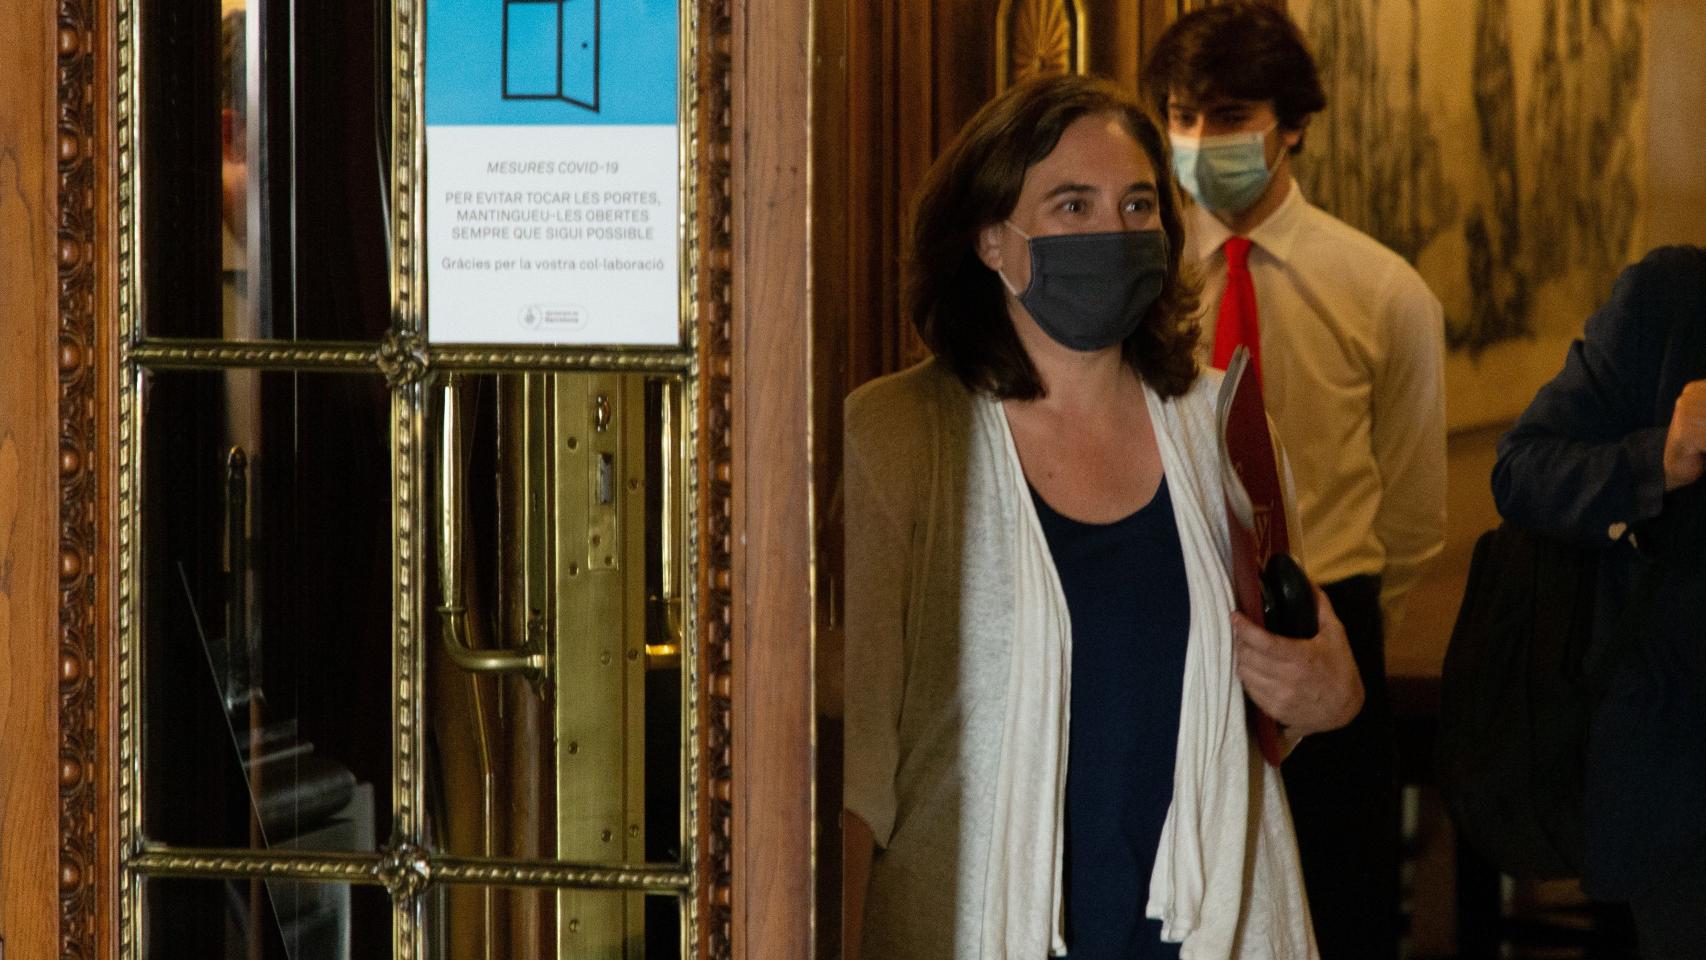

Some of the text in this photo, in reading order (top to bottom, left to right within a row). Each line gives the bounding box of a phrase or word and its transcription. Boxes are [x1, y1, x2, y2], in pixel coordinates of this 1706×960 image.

[487, 161, 619, 174] MESURES COVID-19
[445, 191, 661, 207] PER EVITAR TOCAR LES PORTES,
[457, 209, 649, 222] MANTINGUEU-LES OBERTES
[452, 227, 654, 241] SEMPRE QUE SIGUI POSSIBLE
[495, 259, 515, 272] per
[520, 258, 532, 270] la
[535, 258, 576, 270] vostra
